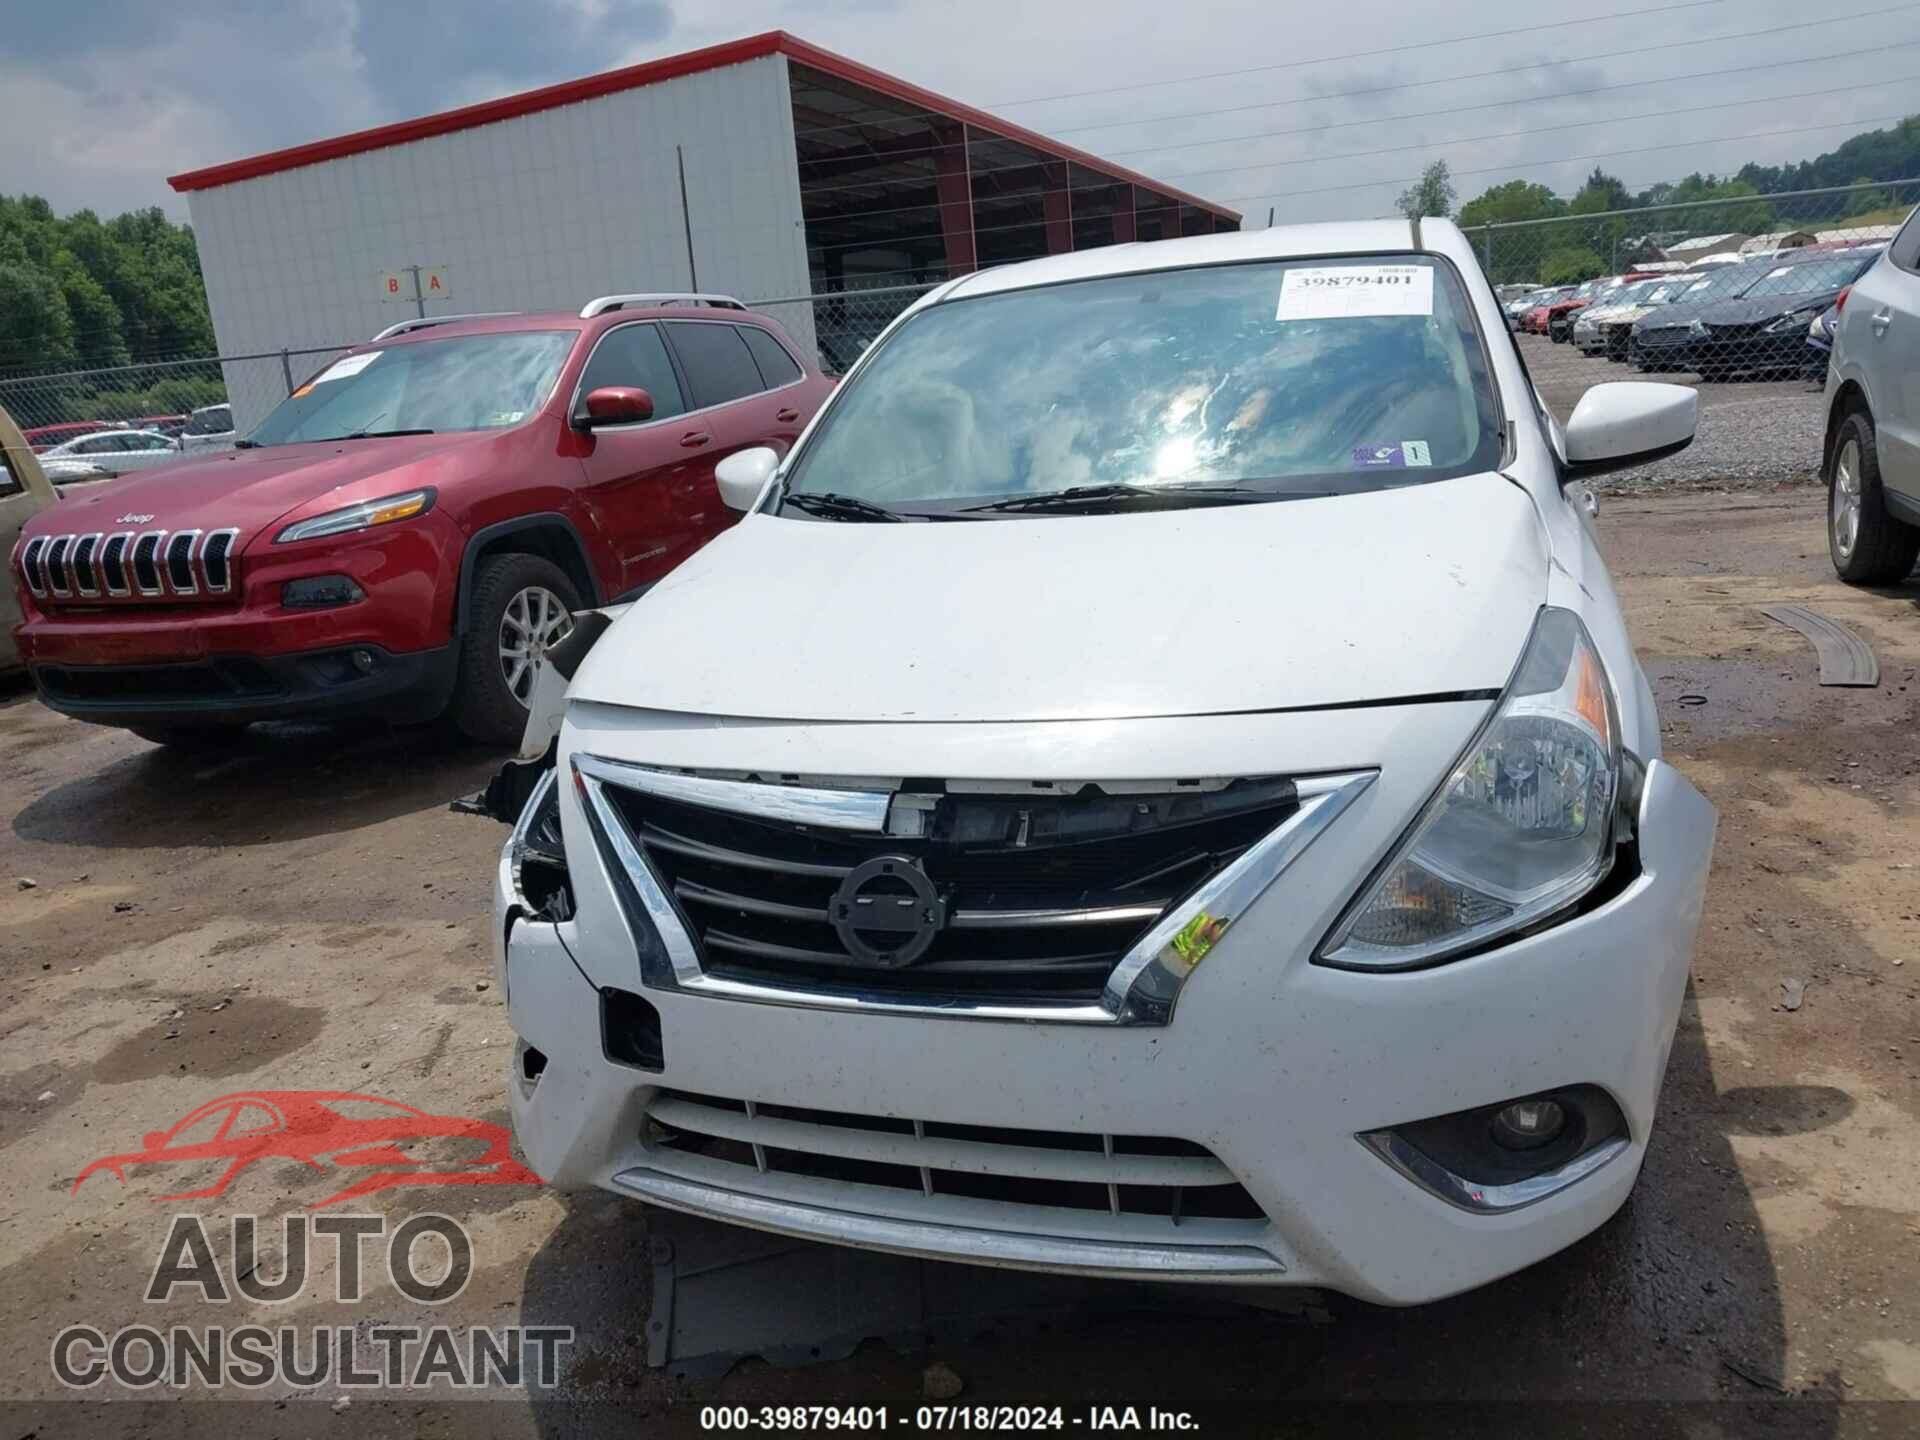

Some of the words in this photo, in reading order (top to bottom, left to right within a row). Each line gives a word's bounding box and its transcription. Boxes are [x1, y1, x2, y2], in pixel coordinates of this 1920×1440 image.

[389, 278, 399, 293] B
[430, 275, 441, 290] A
[1300, 275, 1412, 288] 39879401
[1411, 446, 1419, 461] 1
[115, 512, 155, 526] Jeep
